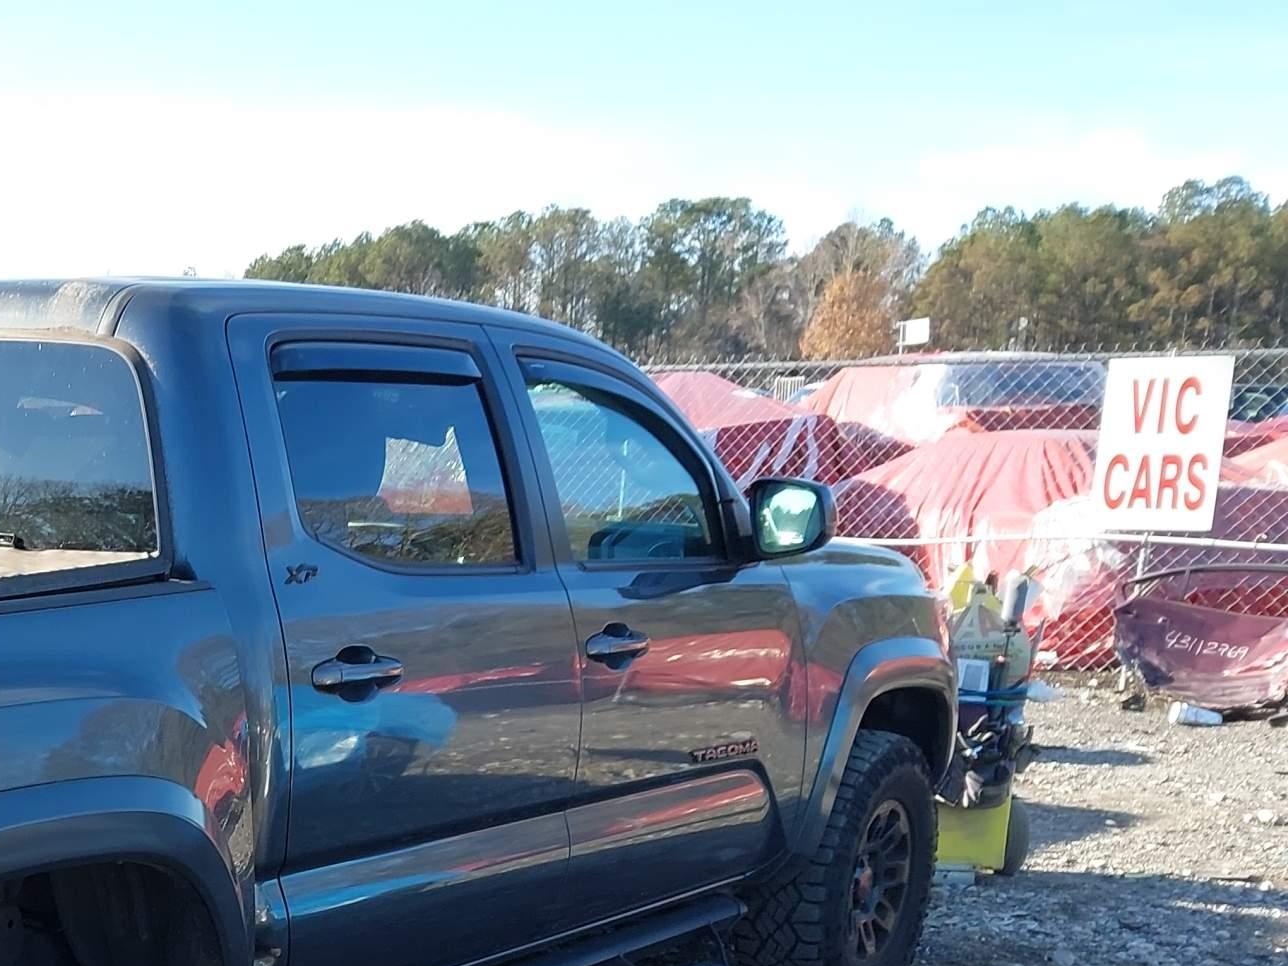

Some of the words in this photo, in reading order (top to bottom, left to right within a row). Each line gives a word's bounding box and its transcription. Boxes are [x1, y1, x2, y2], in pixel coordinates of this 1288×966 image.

[1132, 376, 1202, 435] VIC
[1103, 453, 1209, 511] CARS
[693, 741, 760, 762] TACOMA
